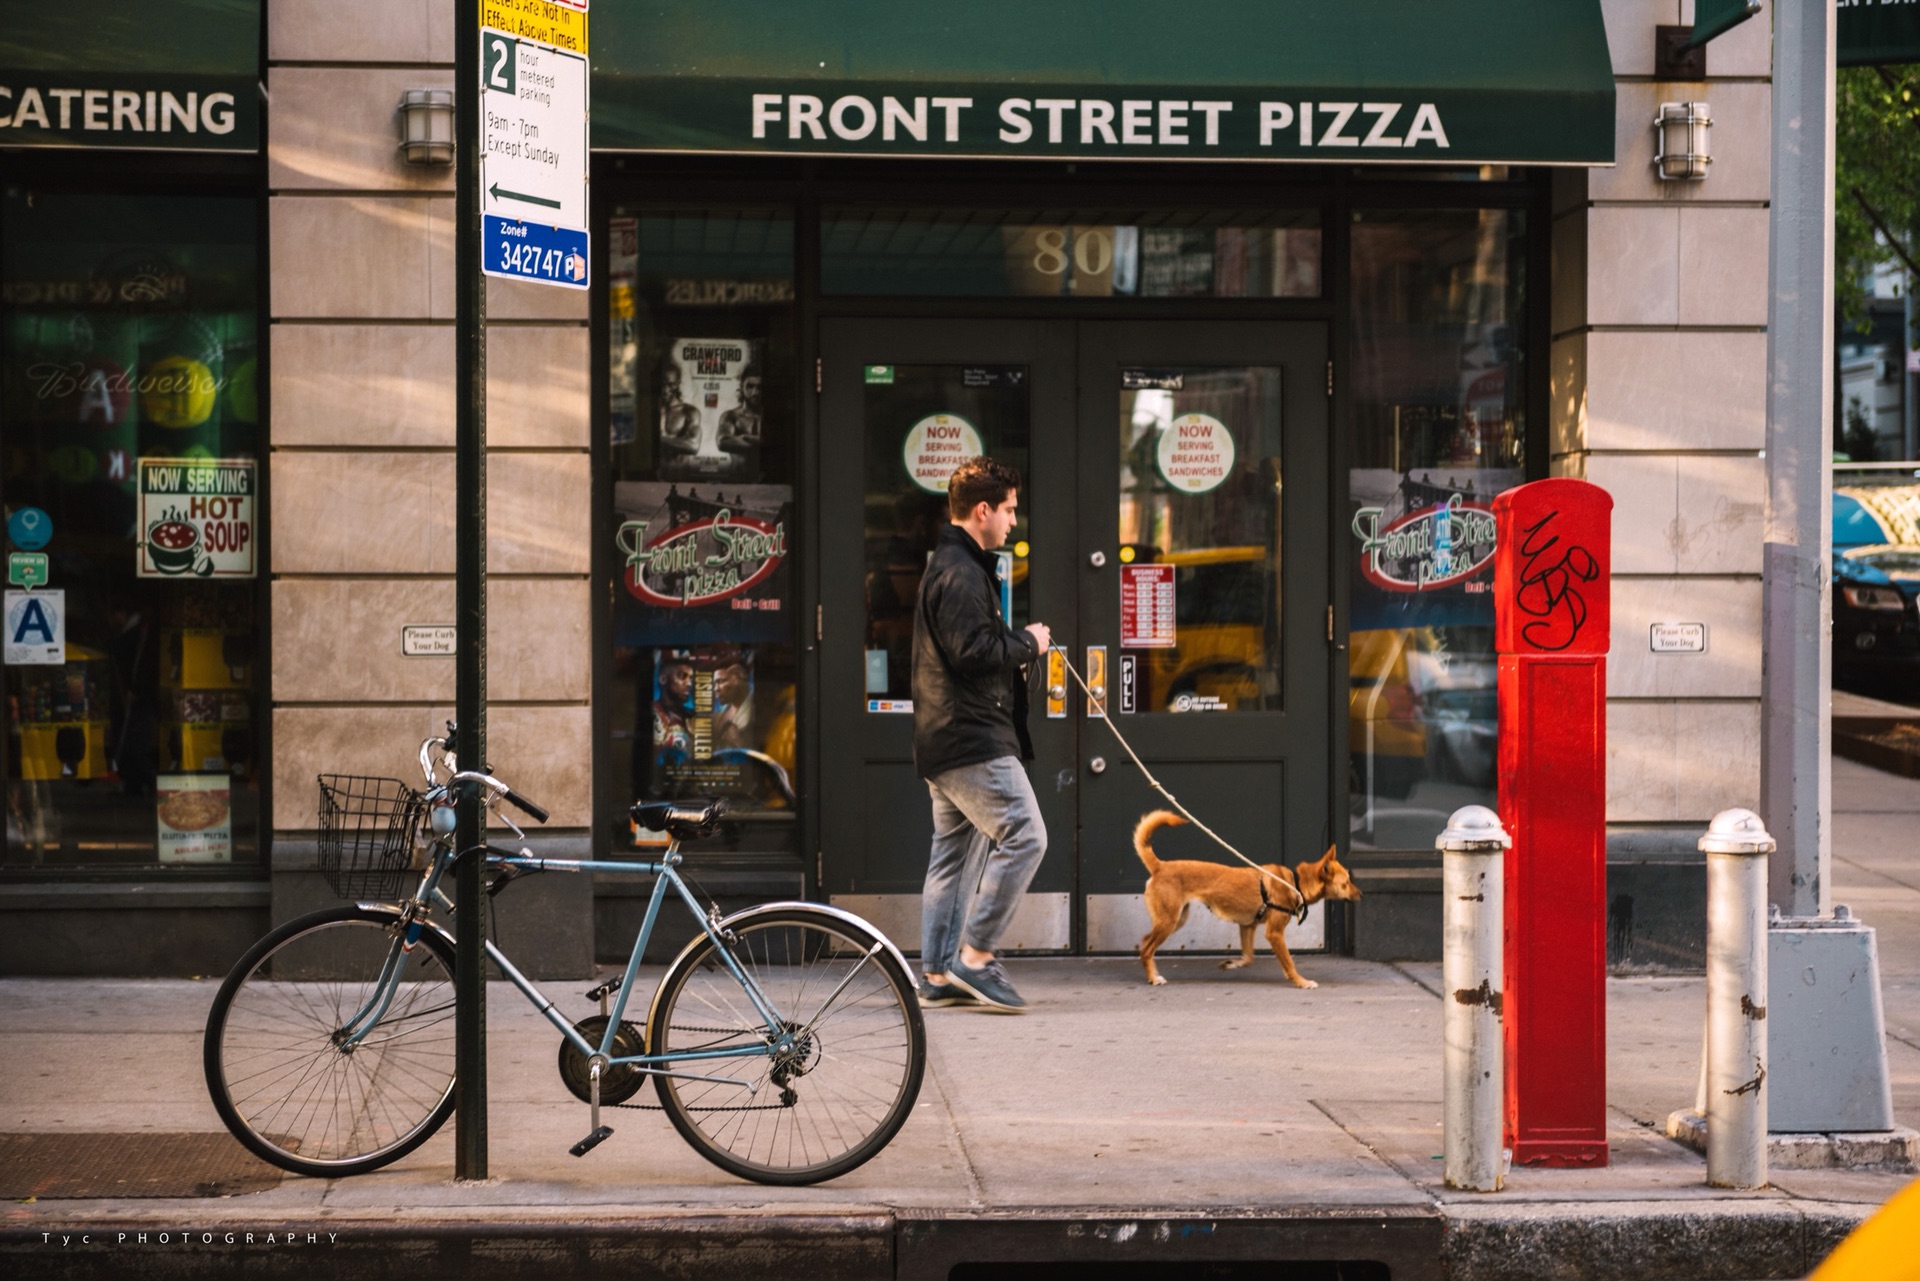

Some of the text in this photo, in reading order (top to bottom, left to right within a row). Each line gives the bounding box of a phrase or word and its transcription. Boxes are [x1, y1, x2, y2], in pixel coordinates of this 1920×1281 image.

[542, 3, 558, 22] Not
[561, 7, 570, 25] In
[487, 9, 577, 50] Effect Above Times
[491, 39, 508, 88] 2
[520, 49, 539, 67] hour
[520, 70, 555, 88] metered
[520, 87, 551, 108] parking
[488, 111, 508, 131] 9am
[519, 118, 539, 139] 7pm
[752, 93, 1451, 148] FRONT STREET PIZZA
[488, 134, 560, 169] Except Sunday
[500, 221, 528, 238] Zone#
[500, 241, 563, 278] 342747
[1033, 230, 1113, 276] 80
[682, 347, 742, 362] CRAWFORD
[697, 361, 727, 375] KHAN
[27, 361, 231, 400] Budweiser
[927, 427, 961, 439] NOW
[1179, 426, 1213, 438] NOW
[925, 443, 962, 452] SERVING
[1177, 441, 1214, 451] SERVING
[918, 455, 969, 465] BREAKFAST
[1171, 454, 1220, 463] BREAKFAST
[148, 467, 248, 493] NOW SERVING
[915, 468, 955, 478] SANDWIC
[1168, 467, 1223, 477] SANDWICHES
[190, 496, 243, 519] HOT
[204, 521, 250, 553] SOUP
[1352, 492, 1496, 572] Front Stre
[616, 508, 787, 587] Front Street
[683, 567, 741, 606] pizza
[13, 598, 55, 643] A
[1655, 627, 1699, 636] Please Curb
[408, 630, 455, 639] Please Curb
[1660, 638, 1694, 648] Your Dog
[414, 641, 449, 651] Your Dog
[695, 671, 713, 712] JOSHUA
[1123, 661, 1132, 708] PULL
[694, 718, 712, 759] MILLER
